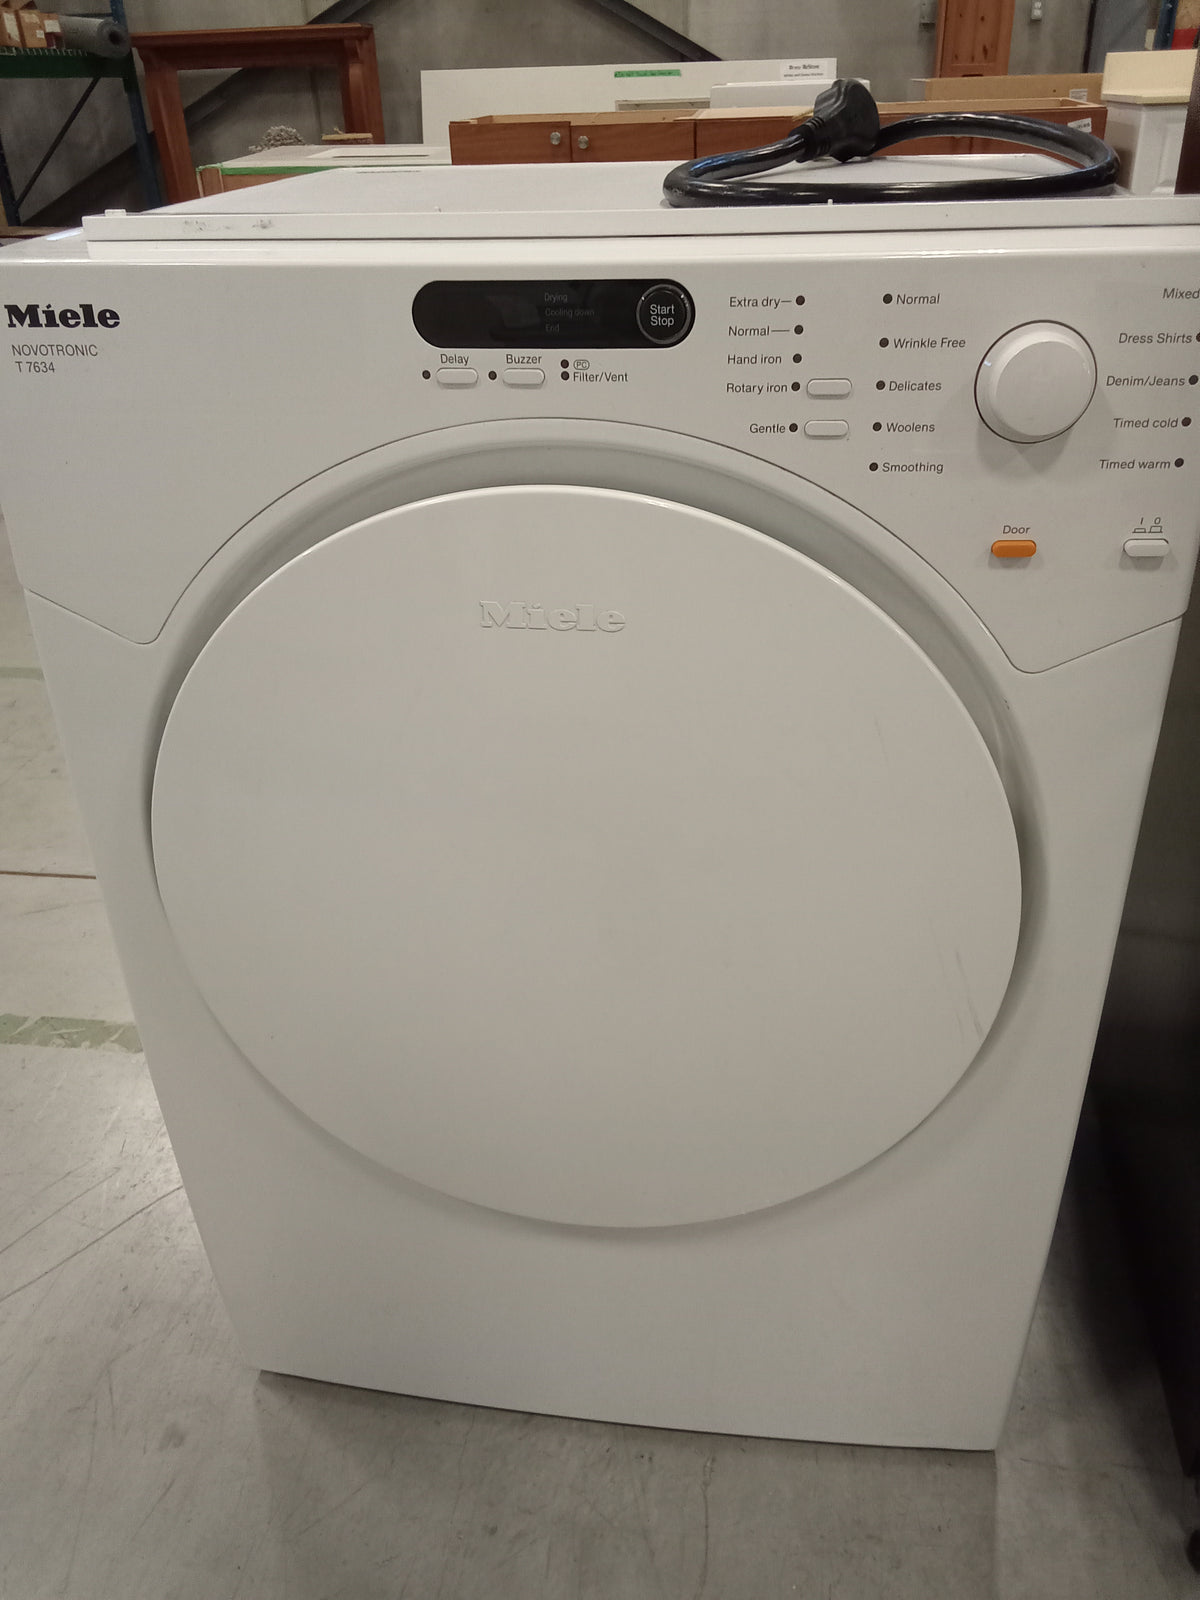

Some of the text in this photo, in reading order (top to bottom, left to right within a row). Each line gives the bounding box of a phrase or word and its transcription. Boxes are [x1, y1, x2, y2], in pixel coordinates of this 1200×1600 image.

[544, 292, 568, 303] Drying
[896, 293, 940, 304] Normal
[1162, 287, 1200, 299] Mixed
[729, 296, 780, 309] Extra dry
[545, 307, 595, 317] Cooling down
[650, 304, 675, 315] Start
[4, 304, 120, 328] Miele
[650, 316, 674, 327] Stop
[545, 323, 560, 333] End
[728, 326, 770, 336] Normal
[893, 338, 966, 348] Wrinkle Free
[1118, 333, 1193, 344] Dress Shirts
[11, 344, 98, 357] NOVOTRONIC
[440, 353, 469, 366] Delay
[506, 354, 542, 365] Buzzer
[576, 361, 587, 369] PC
[727, 354, 782, 365] Hand iron
[15, 361, 55, 373] T 7634
[573, 372, 628, 383] Filter/Vent
[1106, 375, 1185, 387] Denim/Jeans
[726, 382, 787, 395] Rotary iron
[888, 380, 942, 391] Delicates
[749, 423, 785, 434] Gentle
[886, 422, 935, 433] Woolens
[1113, 418, 1178, 428] Timed cold
[882, 462, 944, 474] Smoothing
[1099, 459, 1170, 469] Timed warm
[1002, 525, 1030, 534] Door
[479, 600, 626, 633] Miele
